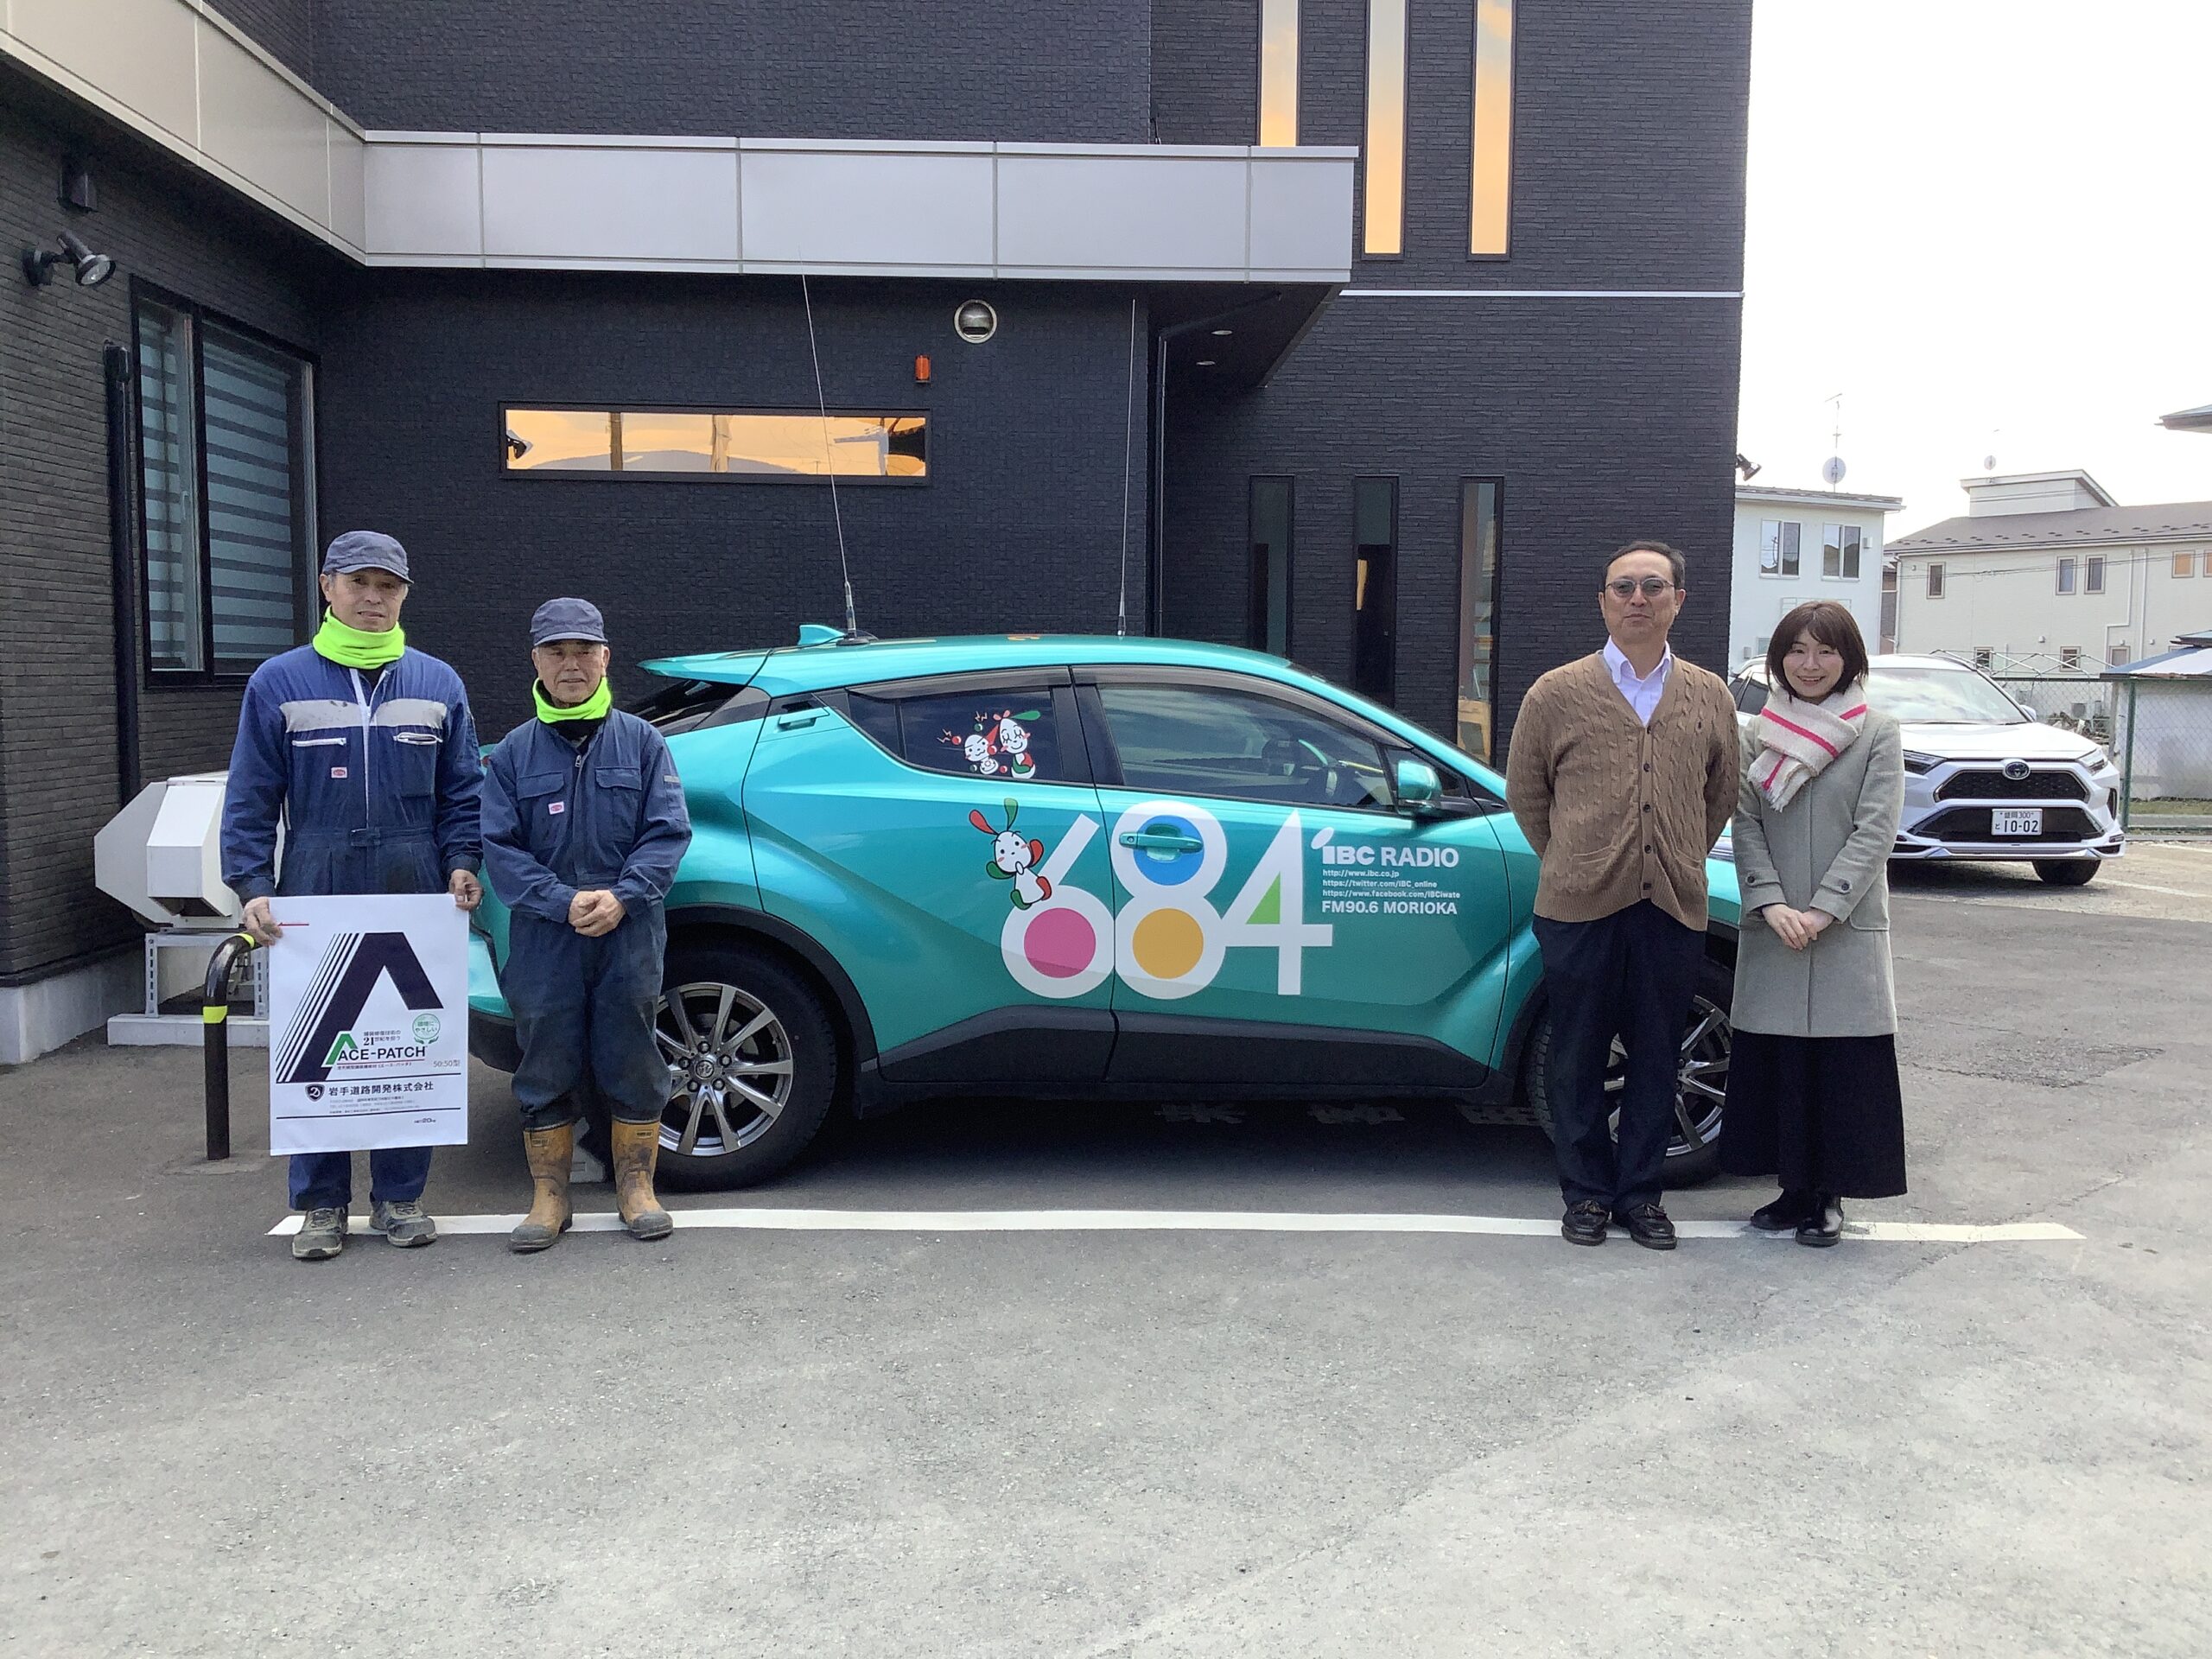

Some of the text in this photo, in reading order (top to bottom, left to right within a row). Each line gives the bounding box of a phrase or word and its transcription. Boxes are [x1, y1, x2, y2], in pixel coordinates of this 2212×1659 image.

[2005, 820, 2038, 832] 10-02
[1381, 846, 1459, 868] RADIO
[1322, 868, 1400, 879] http://www.ibc.co.jp
[1322, 879, 1438, 889] https://twitter.com/IBC_online
[1001, 799, 1333, 1000] 684
[1321, 900, 1458, 915] FM90.6 MORIOKA
[338, 1046, 425, 1061] ACE-PATCH
[328, 1081, 434, 1096] 岩手道路開発株式会社
